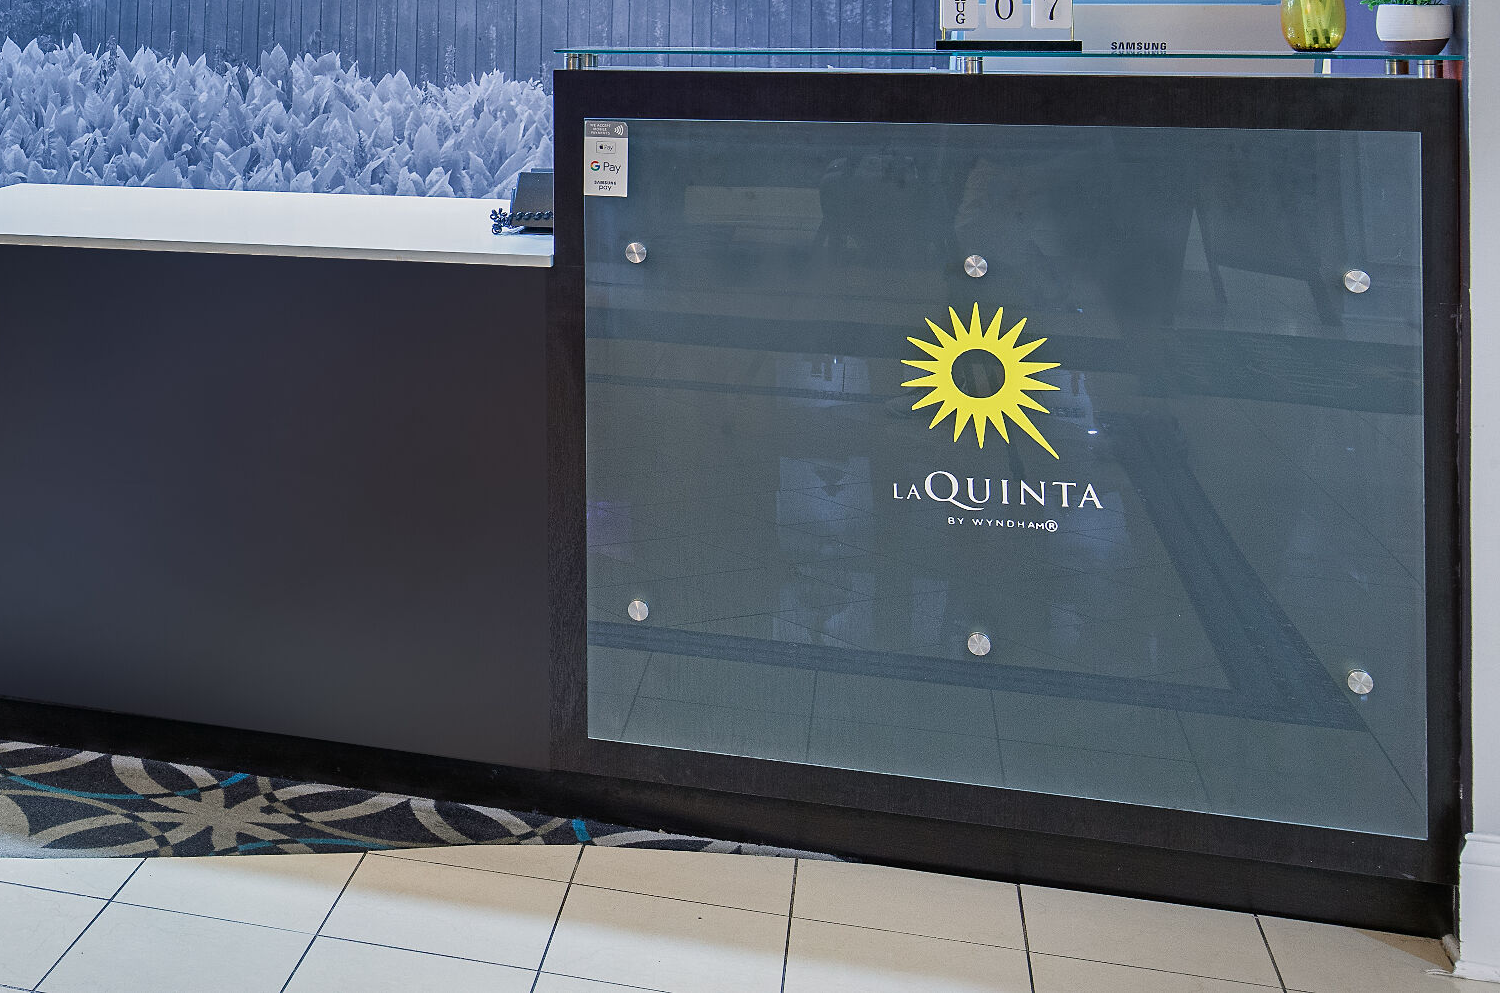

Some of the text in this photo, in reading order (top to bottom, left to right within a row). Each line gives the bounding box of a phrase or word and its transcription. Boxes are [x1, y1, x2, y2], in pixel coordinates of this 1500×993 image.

[1111, 41, 1167, 51] SAMSUNG
[603, 161, 622, 175] Pay
[947, 516, 964, 525] BY
